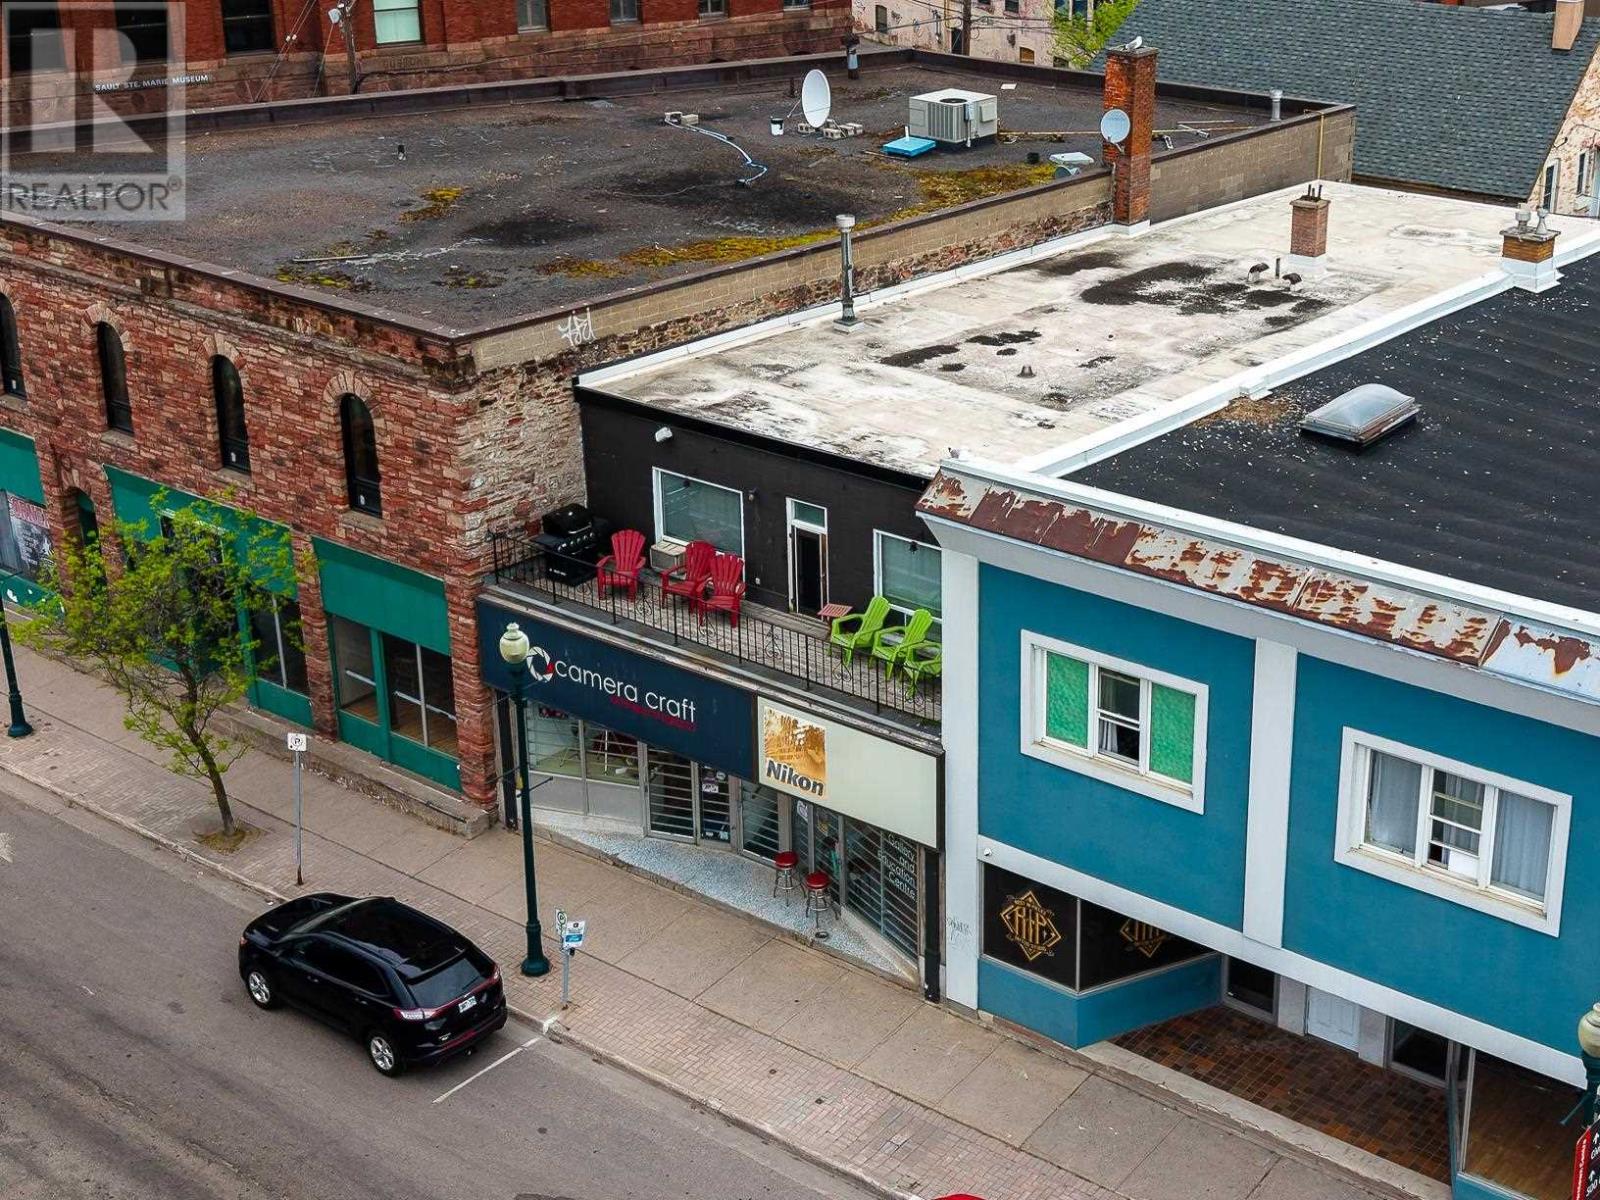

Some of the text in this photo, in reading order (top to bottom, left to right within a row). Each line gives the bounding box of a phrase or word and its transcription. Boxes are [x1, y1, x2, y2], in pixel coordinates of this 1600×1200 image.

[95, 82, 120, 91] SAULT
[142, 79, 168, 87] MARIE
[172, 75, 209, 84] MUSEUM
[554, 658, 638, 703] camera
[645, 691, 696, 723] craft
[766, 760, 825, 797] Nikon
